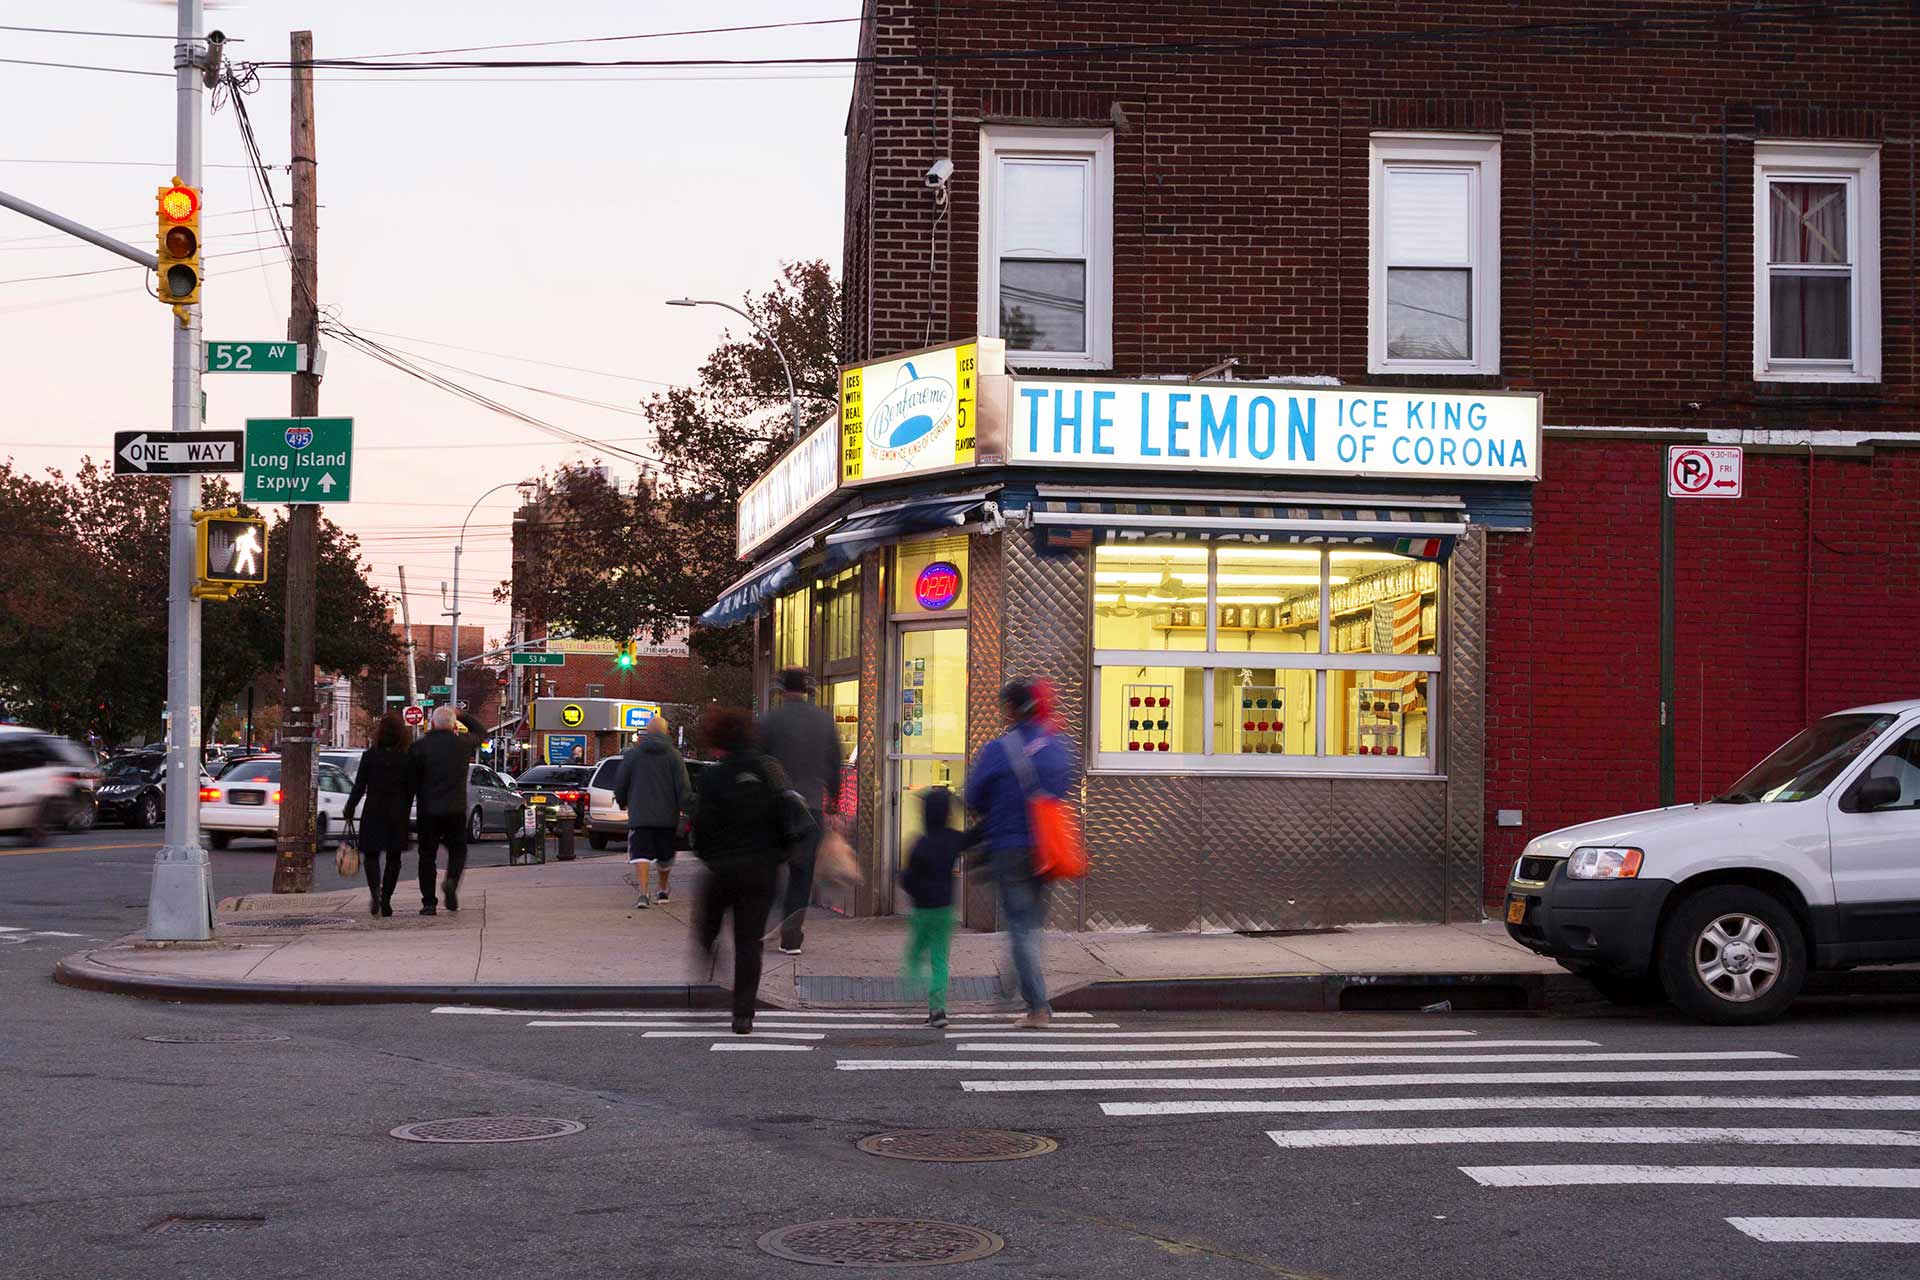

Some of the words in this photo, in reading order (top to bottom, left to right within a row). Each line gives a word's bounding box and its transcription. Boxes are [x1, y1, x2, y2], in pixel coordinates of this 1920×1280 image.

[216, 345, 252, 369] 52
[268, 346, 286, 359] AV
[960, 358, 974, 373] ICES
[846, 375, 860, 389] ICES
[963, 377, 970, 389] IN
[845, 391, 861, 404] WITH
[845, 407, 861, 420] REAL
[958, 398, 973, 429] 5
[1337, 399, 1388, 428] ICE
[1407, 401, 1487, 431] KING
[844, 422, 863, 435] PIECES
[1021, 388, 1115, 455] THE
[1140, 392, 1316, 462] LEMON
[288, 434, 309, 445] 495
[849, 435, 857, 447] OF
[955, 437, 976, 451] FLAVORS
[130, 444, 169, 461] ONE
[187, 444, 227, 461] WAY
[845, 447, 861, 461] FRUIT
[1337, 434, 1376, 463] OF
[1392, 436, 1528, 468] CORONA
[250, 453, 289, 470] Long
[296, 452, 346, 467] Island
[846, 464, 853, 476] IN
[854, 463, 860, 476] IT
[1719, 464, 1733, 473] FRI
[256, 475, 310, 492] Expwy
[919, 575, 958, 598] OPEN
[528, 655, 538, 663] 53
[538, 655, 548, 663] Av
